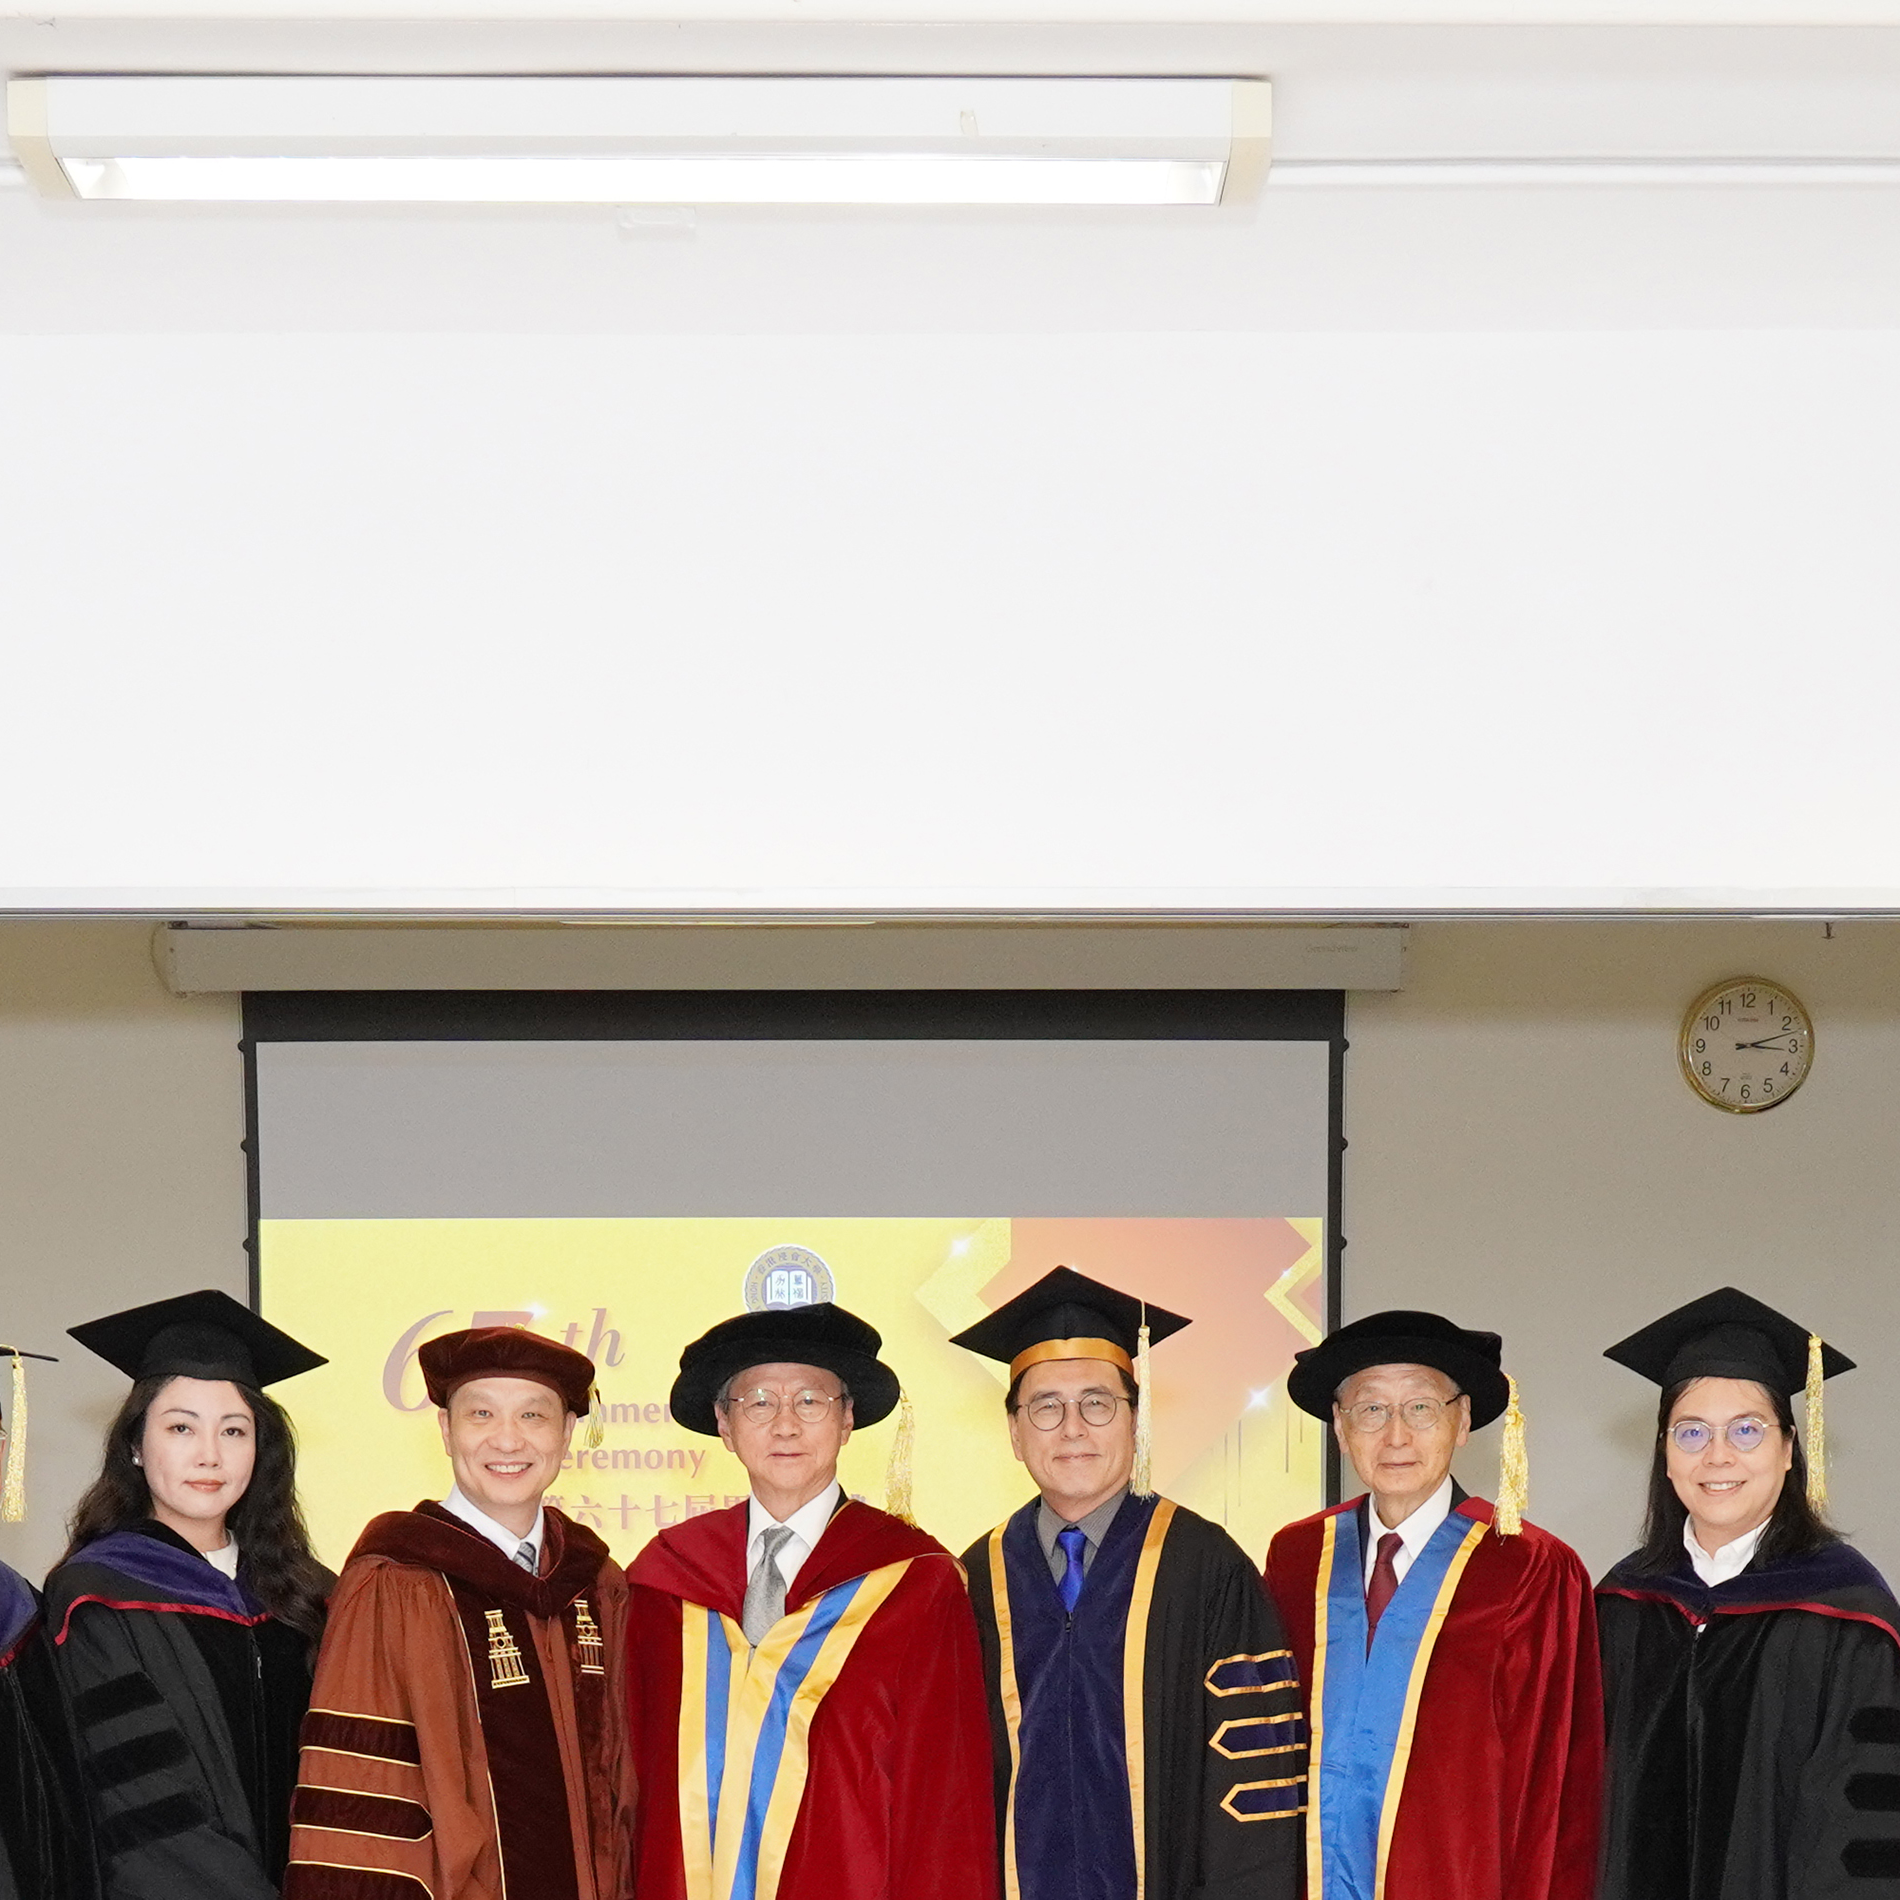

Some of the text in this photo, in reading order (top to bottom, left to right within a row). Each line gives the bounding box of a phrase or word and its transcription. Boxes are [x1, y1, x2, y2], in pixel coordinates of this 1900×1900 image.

[1719, 1000, 1732, 1015] 11
[1740, 993, 1756, 1008] 12
[1767, 1000, 1774, 1015] 1
[1703, 1016, 1720, 1031] 10
[1781, 1016, 1792, 1031] 2
[1695, 1039, 1706, 1053] 9
[1788, 1039, 1798, 1054] 3
[1702, 1061, 1712, 1076] 8
[1780, 1062, 1789, 1076] 4
[1721, 1078, 1730, 1092] 7
[1740, 1084, 1751, 1099] 6
[1763, 1078, 1773, 1093] 5
[560, 1448, 706, 1479] eremony
